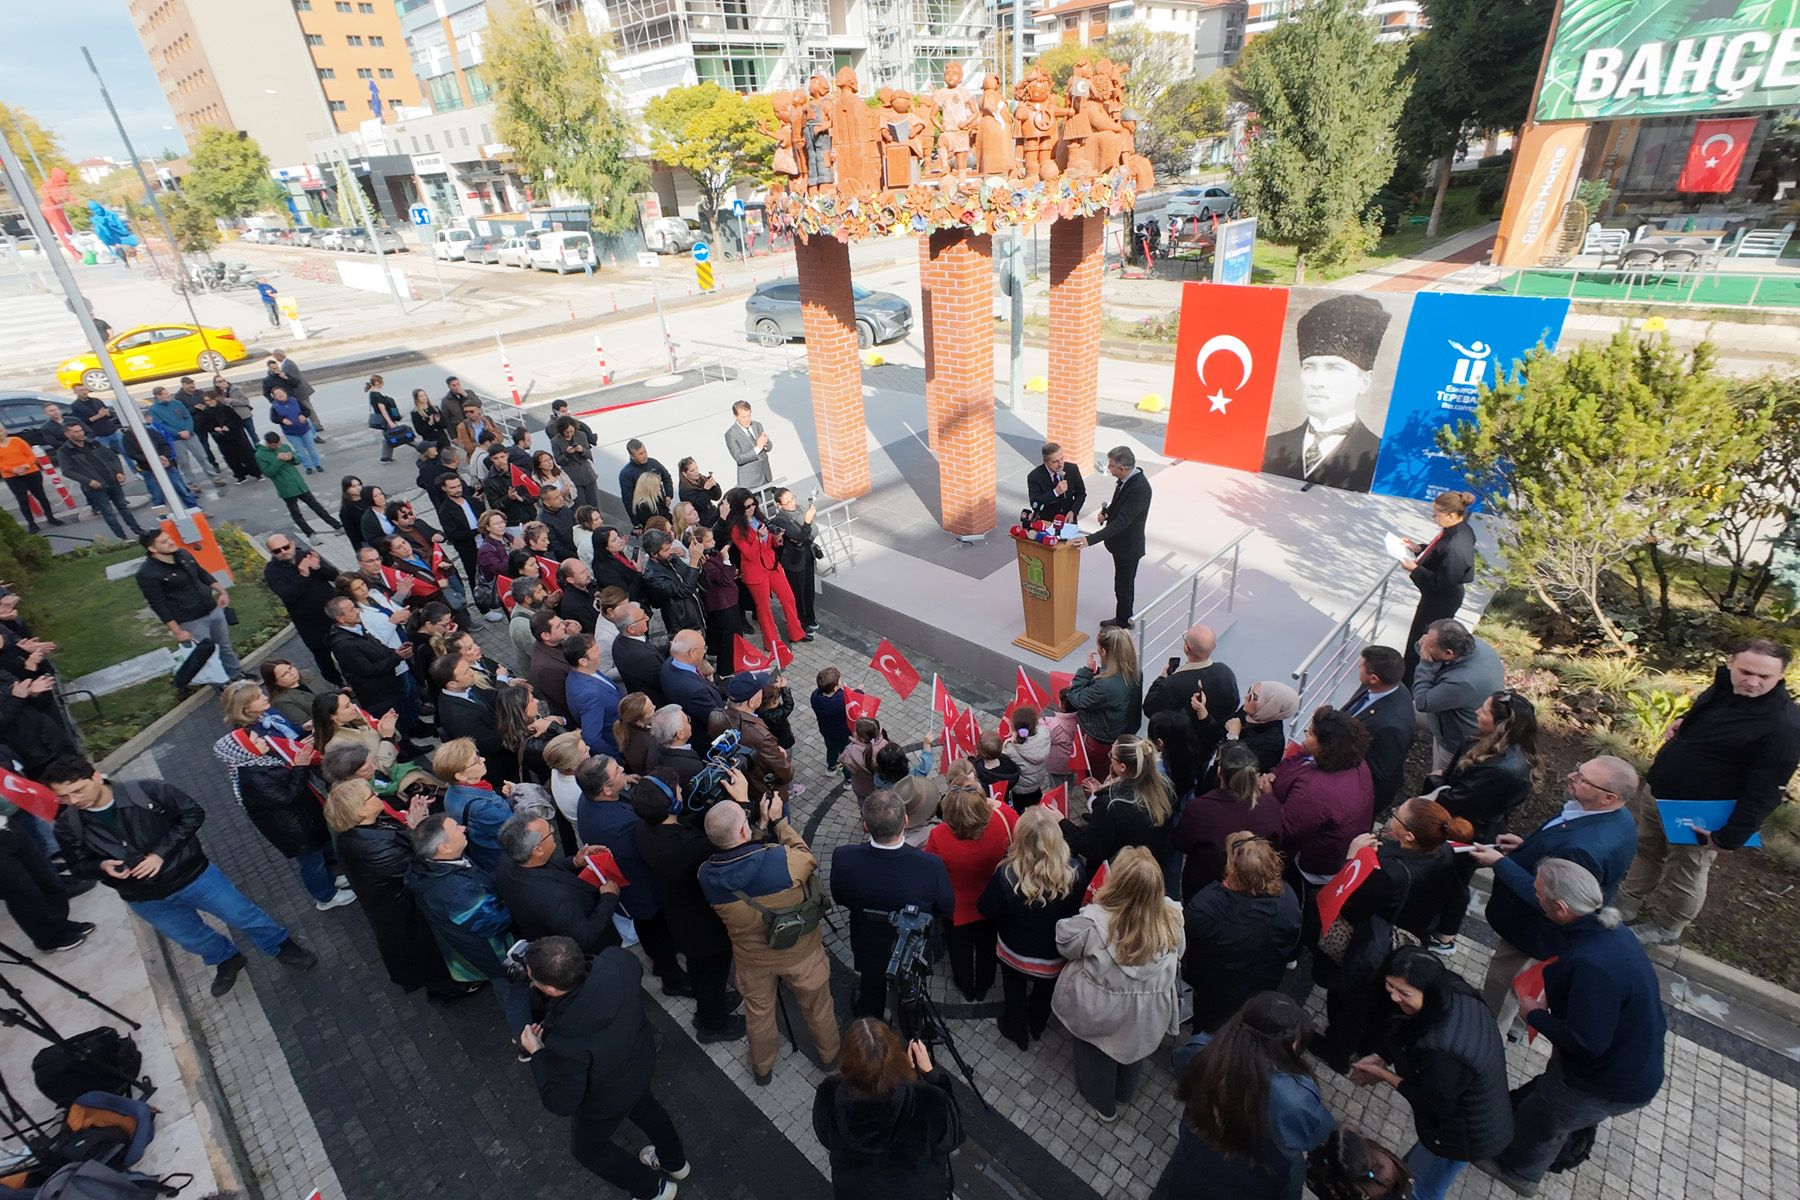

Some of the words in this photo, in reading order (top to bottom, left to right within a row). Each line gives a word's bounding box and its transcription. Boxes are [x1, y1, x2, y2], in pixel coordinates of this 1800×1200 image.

[1574, 28, 1800, 101] BAHÇE
[1537, 147, 1568, 197] Home
[1437, 391, 1477, 404] TEPEBA
